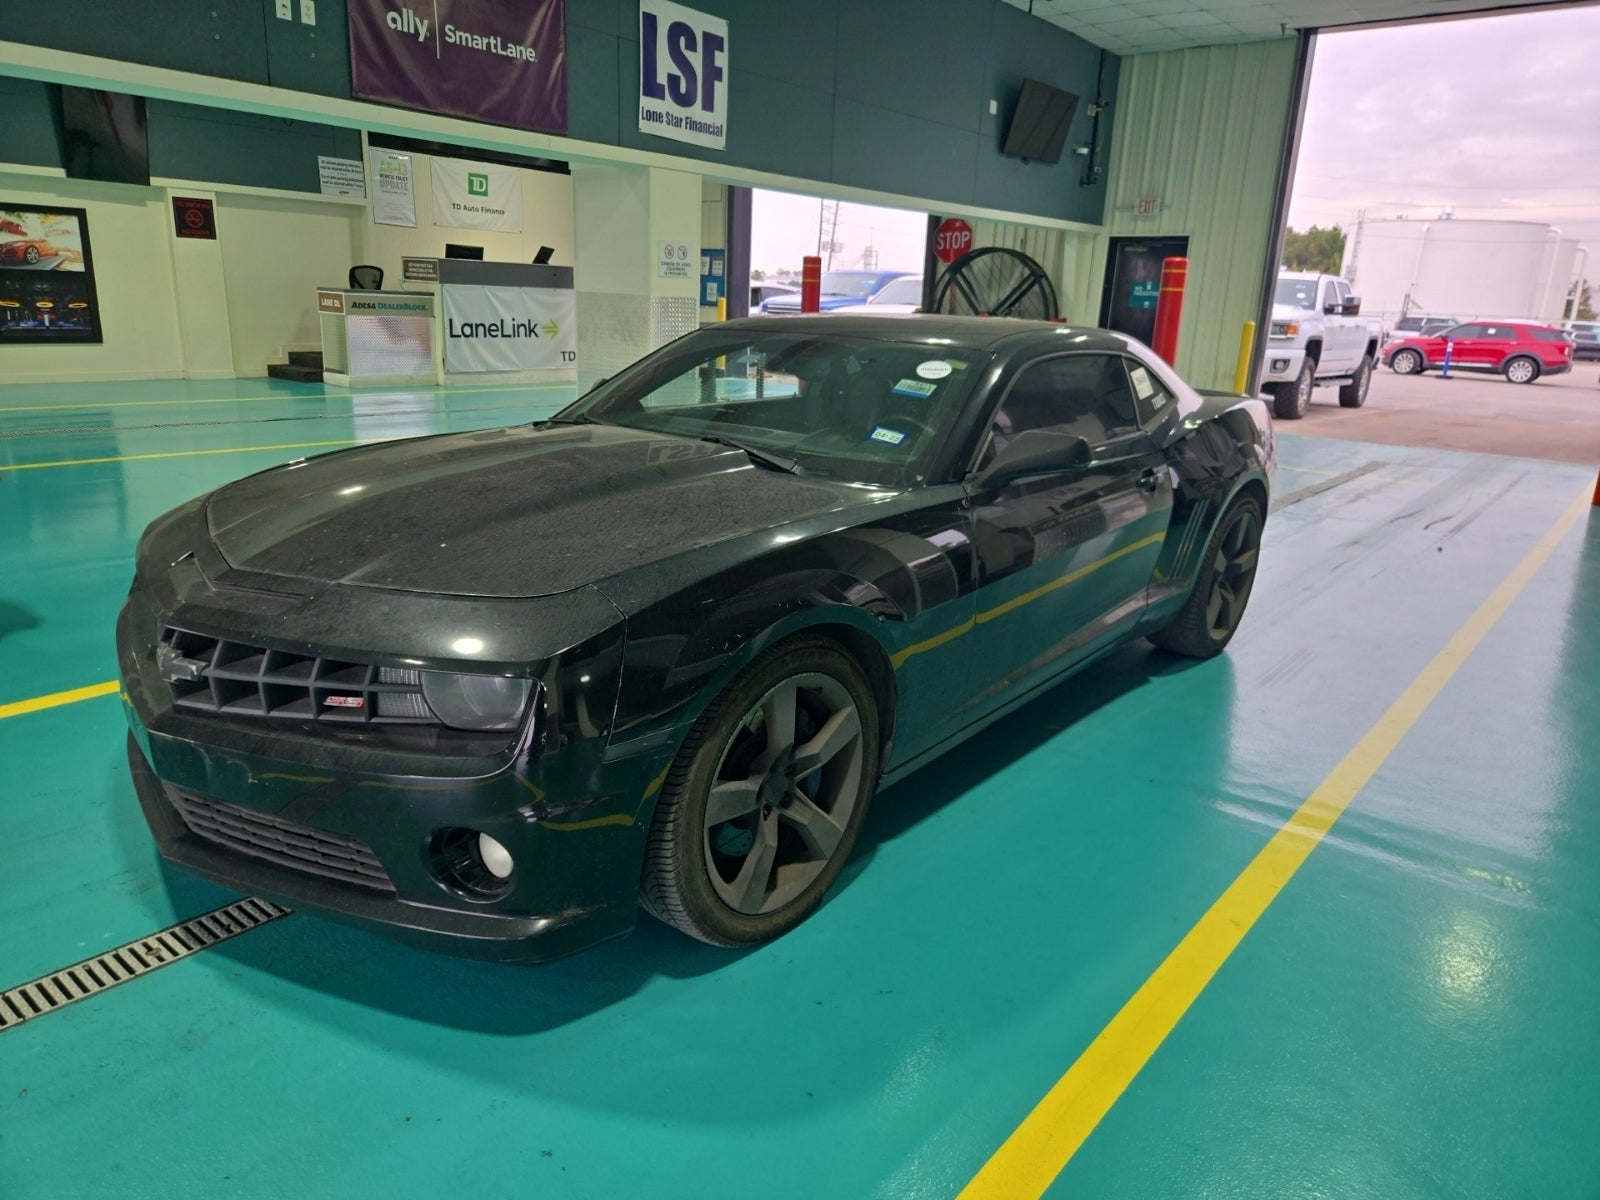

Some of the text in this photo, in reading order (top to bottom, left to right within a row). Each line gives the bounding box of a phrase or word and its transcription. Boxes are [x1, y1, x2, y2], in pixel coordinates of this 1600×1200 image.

[386, 7, 536, 62] ally SmartLane
[642, 11, 724, 113] LSF
[641, 106, 723, 137] Lone Star Financial
[379, 179, 409, 191] UPDATE
[470, 176, 487, 192] TD
[463, 204, 479, 213] Auto
[480, 206, 505, 215] Finance
[1137, 199, 1158, 214] EXIT
[936, 231, 970, 250] STOP
[321, 297, 334, 306] LANE
[448, 317, 539, 338] LaneLink
[560, 351, 576, 362] TD
